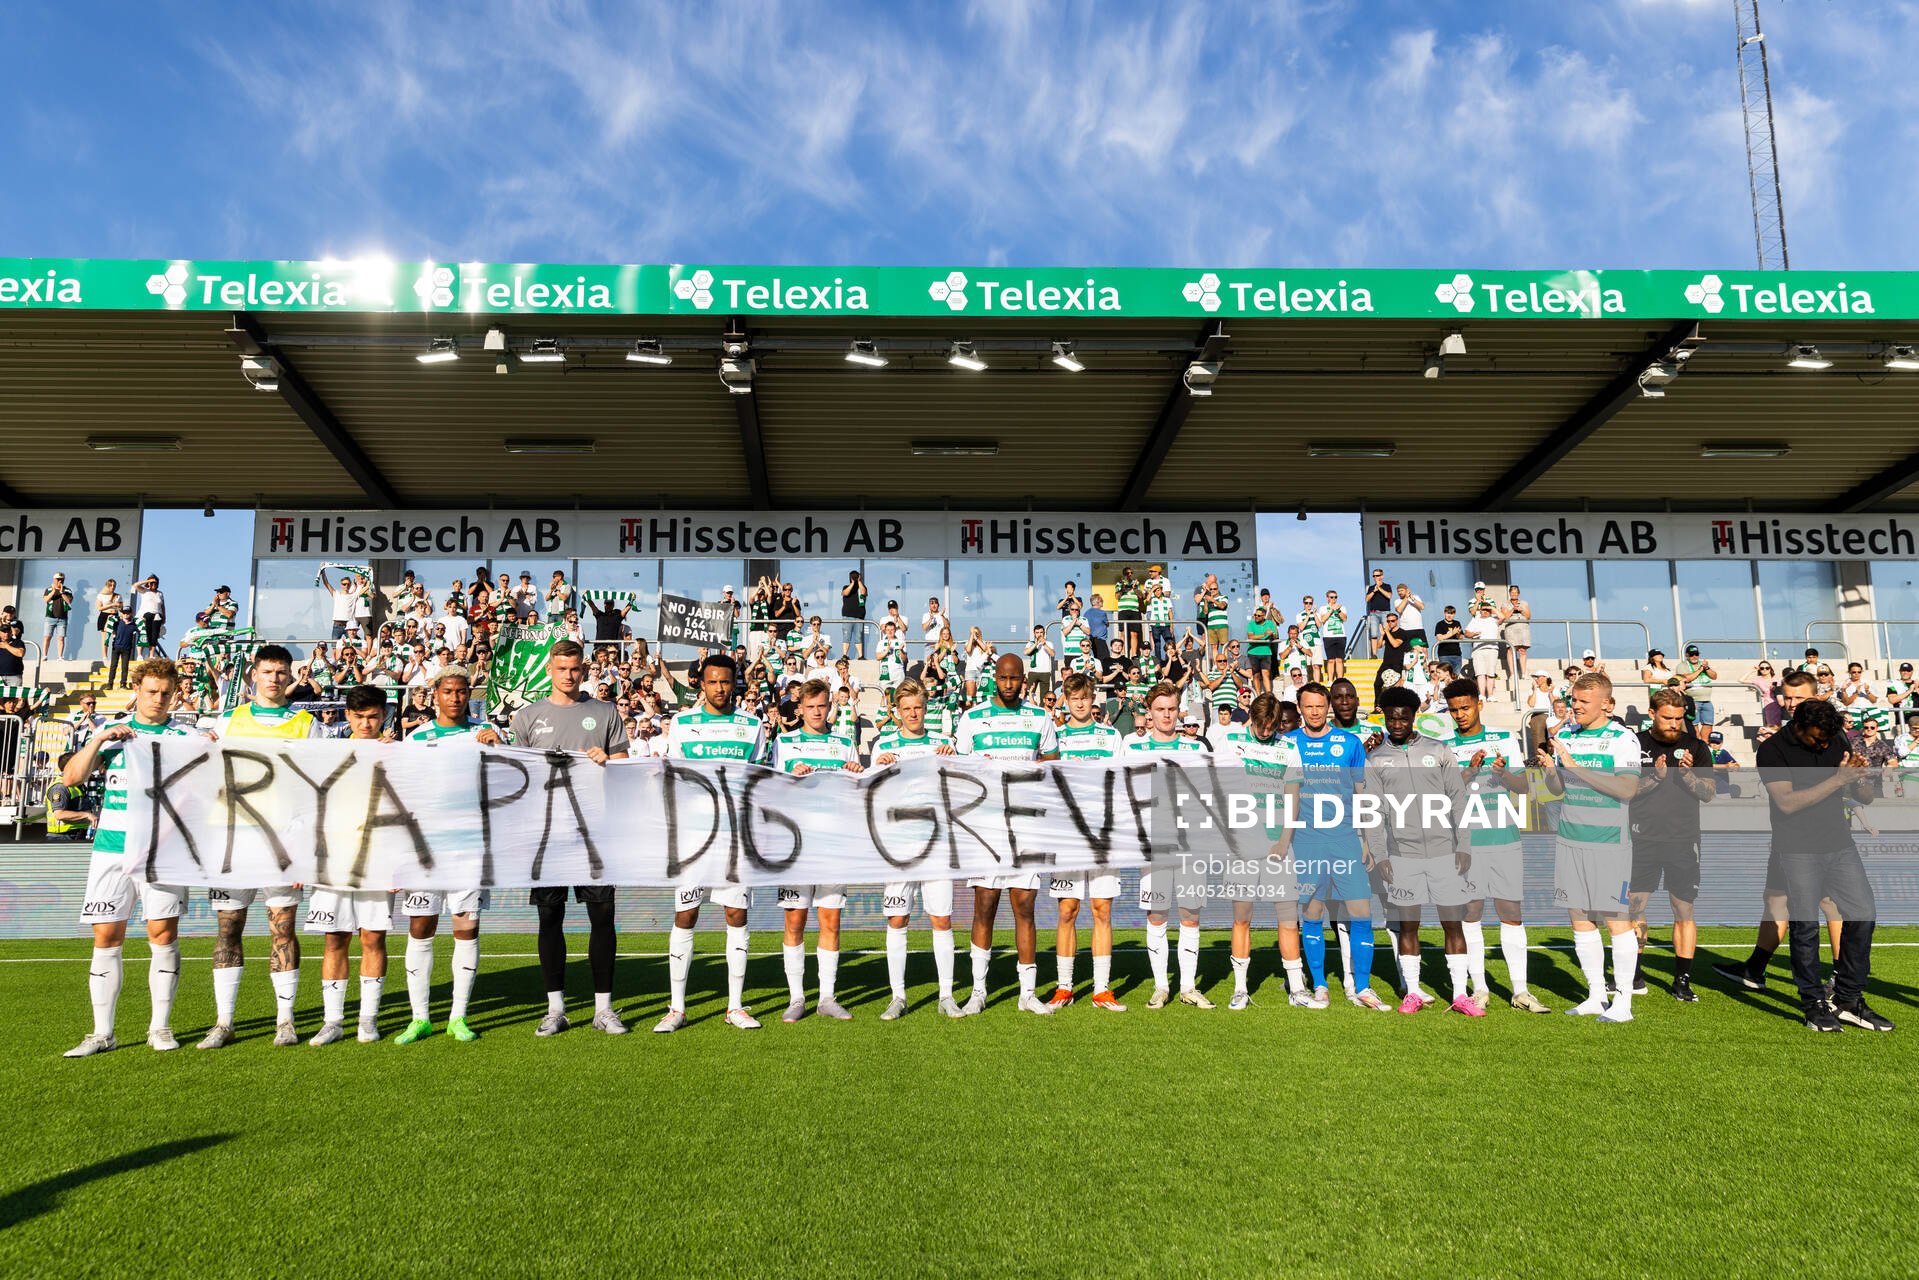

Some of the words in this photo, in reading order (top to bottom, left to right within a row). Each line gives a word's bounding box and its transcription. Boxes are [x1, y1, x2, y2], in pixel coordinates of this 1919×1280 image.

[197, 273, 347, 305] Telexia
[463, 276, 612, 309] Telexia
[722, 277, 869, 310] Telexia
[976, 278, 1121, 311] Telexia
[1230, 280, 1374, 313] Telexia
[1481, 281, 1626, 313] Telexia
[1731, 282, 1875, 313] Telexia
[58, 517, 121, 552] AB
[300, 516, 483, 552] Hisstech
[499, 518, 561, 552] AB
[650, 517, 828, 553] Hisstech
[843, 519, 904, 553] AB
[990, 518, 1166, 554] Hisstech
[1182, 520, 1241, 554] AB
[1408, 518, 1583, 554] Hisstech
[1598, 520, 1657, 554] AB
[1740, 519, 1915, 554] Hisstech
[668, 602, 686, 614] NO
[688, 606, 725, 620] JABIR
[684, 617, 706, 630] 164
[663, 624, 681, 637] NO
[683, 628, 724, 643] PARTY
[705, 746, 744, 757] Telexia
[994, 736, 1033, 746] Telexia
[1303, 763, 1341, 772] Telexia
[144, 741, 435, 887] KRYA
[662, 758, 802, 883] DIG
[864, 754, 1242, 870] GREVEN
